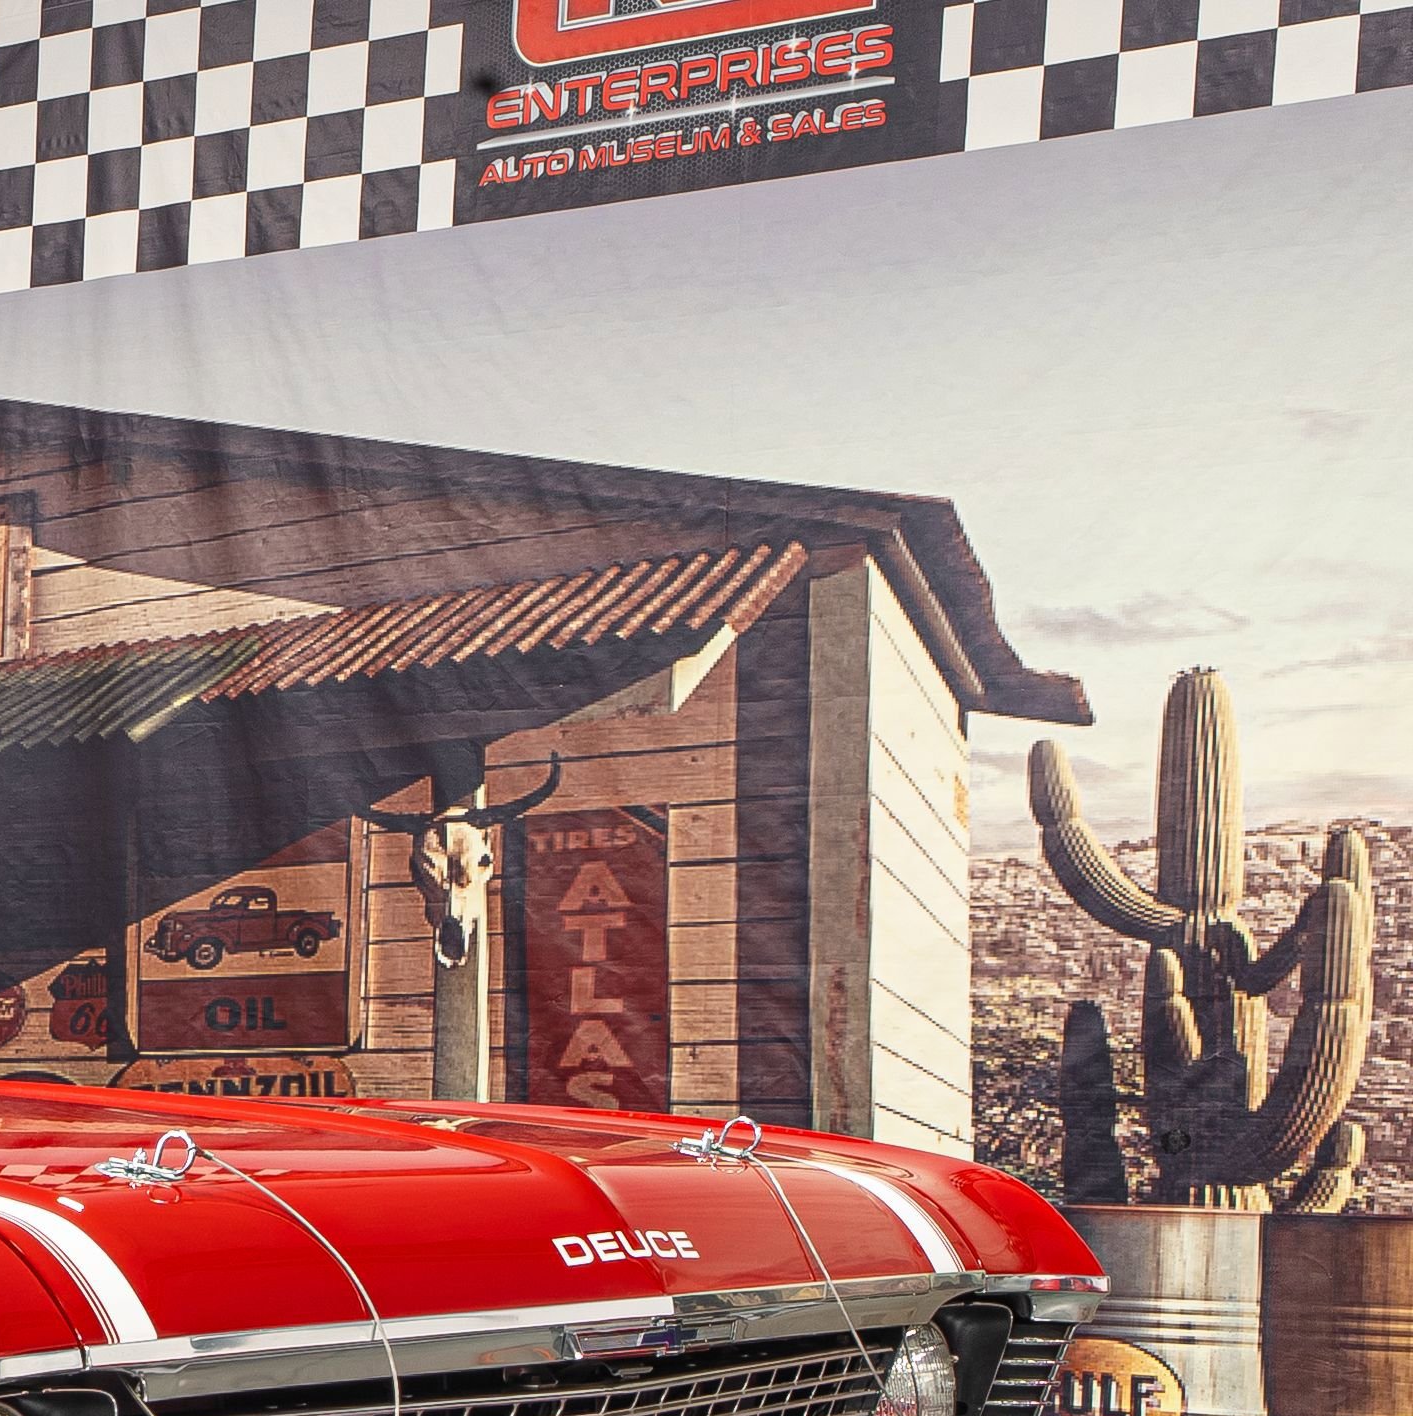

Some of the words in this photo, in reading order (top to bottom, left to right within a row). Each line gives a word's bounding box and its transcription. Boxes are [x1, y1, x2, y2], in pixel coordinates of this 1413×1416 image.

[485, 23, 893, 130] ENTERPRISES
[478, 149, 573, 187] AUTO
[579, 124, 730, 170] MUSEUM
[740, 118, 762, 147] &
[767, 98, 887, 142] SALES
[529, 825, 637, 853] TIRES
[557, 861, 634, 1110] ATLAS
[205, 997, 287, 1031] OIL
[129, 1070, 347, 1097] NNZOIL
[552, 1230, 700, 1267] DEUCE
